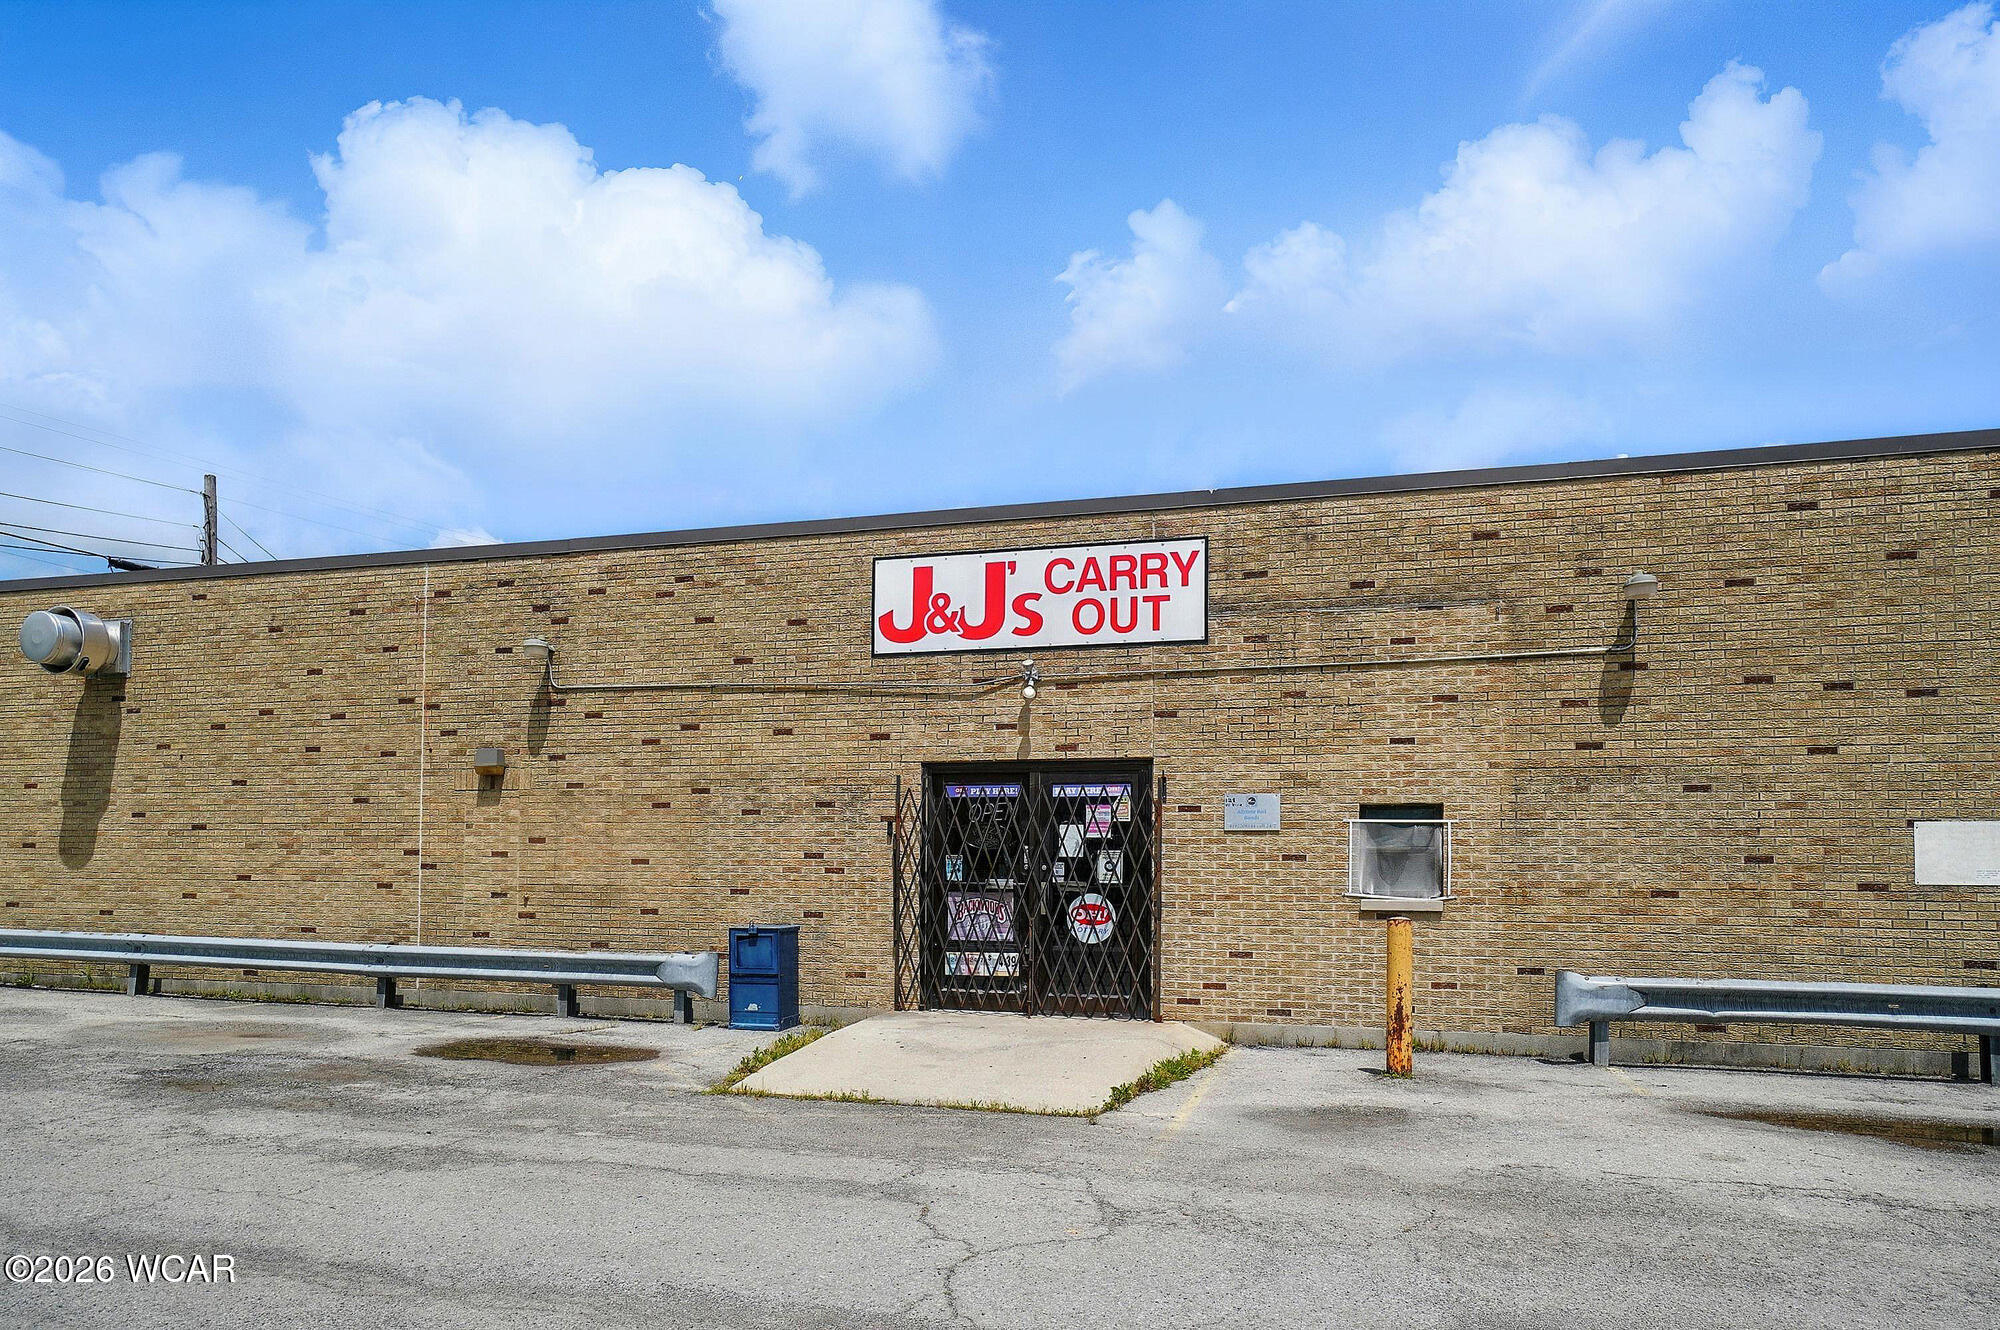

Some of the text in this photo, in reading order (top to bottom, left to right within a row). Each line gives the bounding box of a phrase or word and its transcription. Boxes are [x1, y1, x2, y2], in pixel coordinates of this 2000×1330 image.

[1044, 549, 1200, 594] CARRY
[1072, 594, 1171, 635] OUT
[992, 787, 1019, 795] HRE!
[1073, 924, 1109, 935] OTRY
